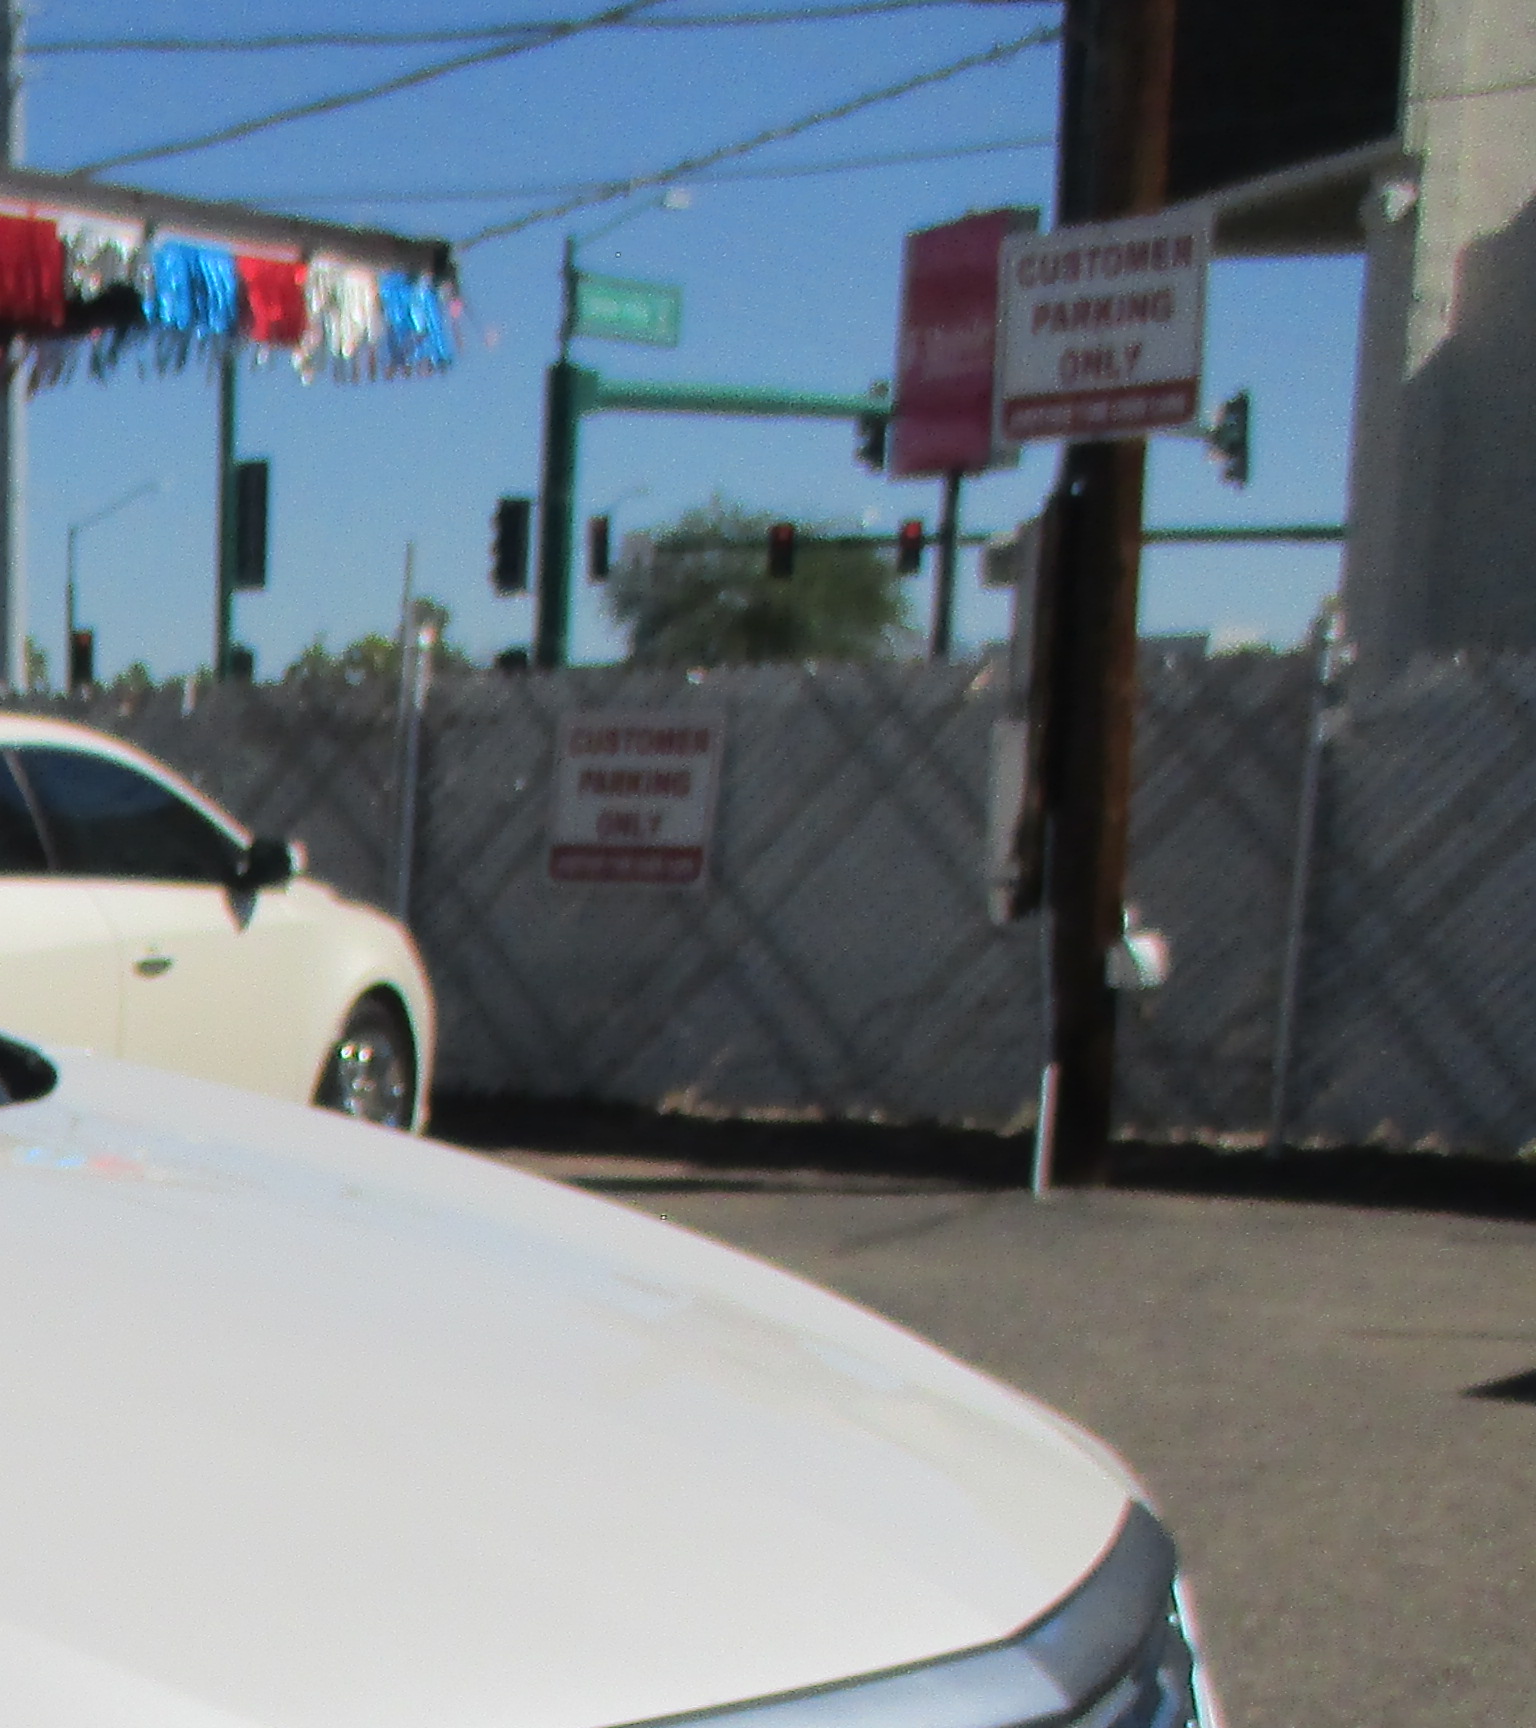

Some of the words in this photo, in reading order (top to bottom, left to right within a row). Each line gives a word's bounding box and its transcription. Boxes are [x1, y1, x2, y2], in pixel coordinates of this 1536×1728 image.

[1019, 236, 1191, 288] CUSTOMER
[1033, 289, 1174, 334] PARKING
[1060, 343, 1142, 385] ONLY
[569, 728, 709, 756] CUSTOMER
[578, 770, 691, 797] PARKING
[597, 810, 663, 840] ONLY
